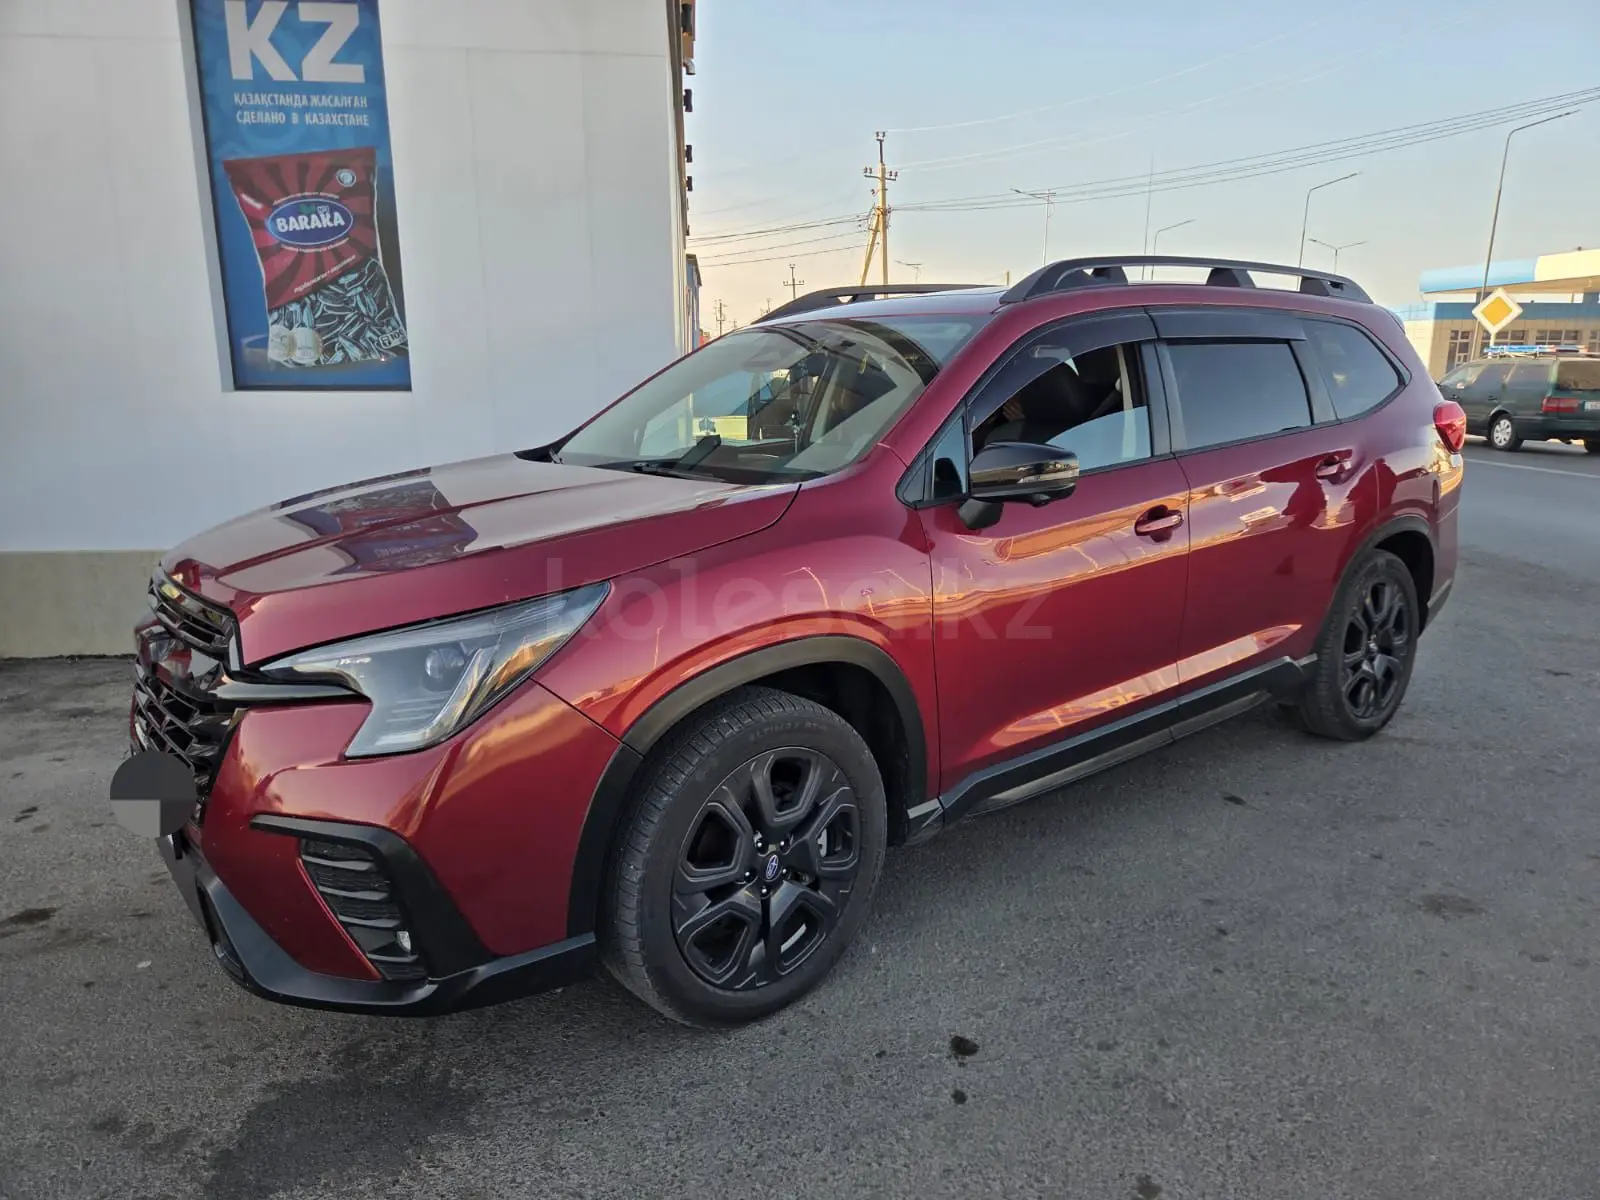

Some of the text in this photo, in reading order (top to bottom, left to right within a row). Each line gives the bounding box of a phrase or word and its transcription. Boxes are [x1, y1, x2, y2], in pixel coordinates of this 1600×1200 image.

[224, 0, 365, 83] KZ
[233, 92, 367, 108] ҚАЗАҚСТАНДА ЖАСАЛҒАН
[236, 110, 369, 126] СДЕЛАНО В КАЗАХСТАНЕ
[276, 211, 346, 233] BARAKA
